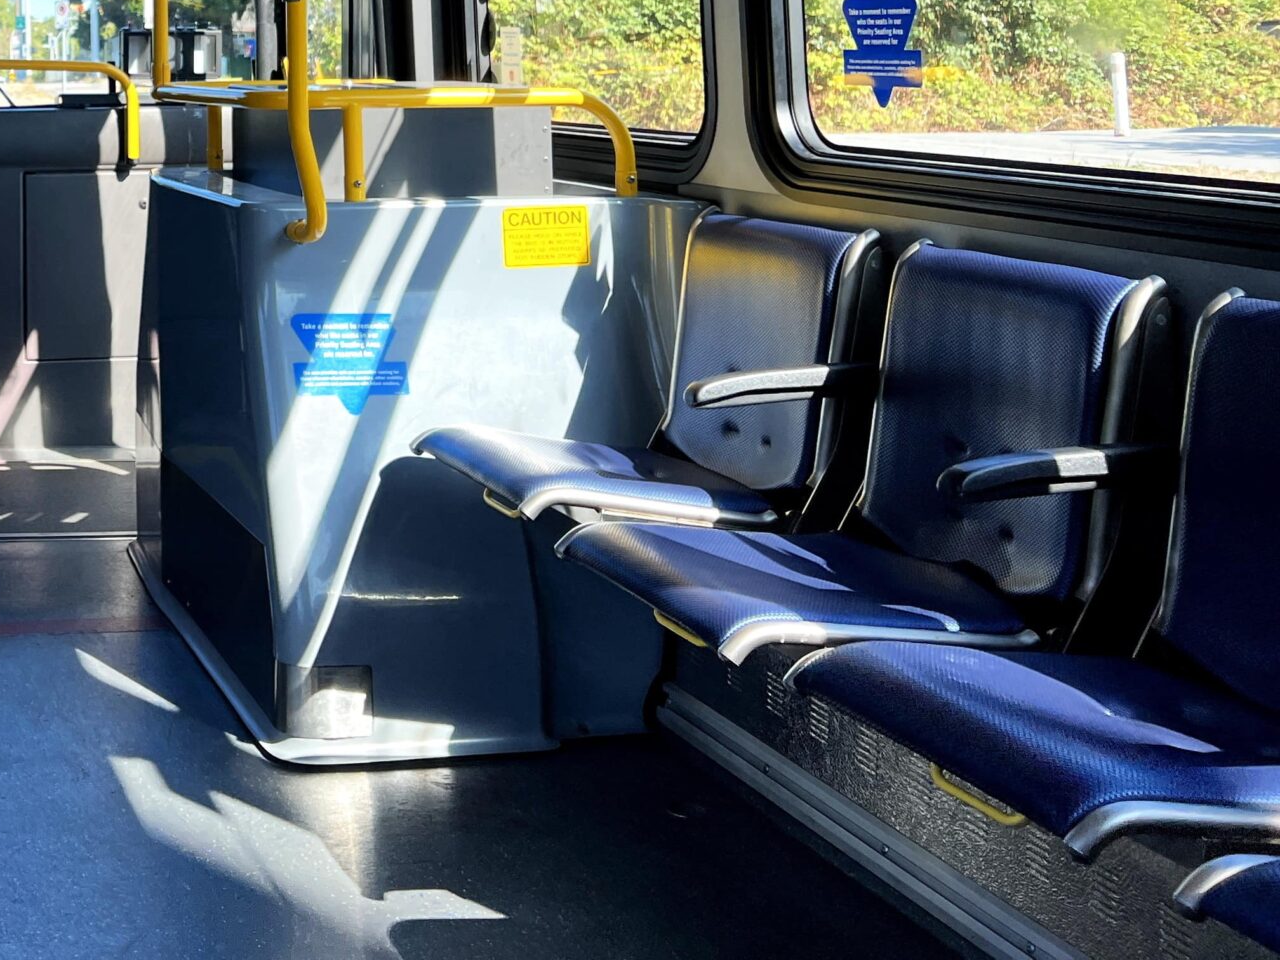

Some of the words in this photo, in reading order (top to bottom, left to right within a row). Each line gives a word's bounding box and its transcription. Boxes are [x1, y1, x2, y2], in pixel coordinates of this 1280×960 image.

[857, 28, 873, 36] Priority
[874, 28, 892, 36] Seating
[508, 211, 581, 227] CAUTION
